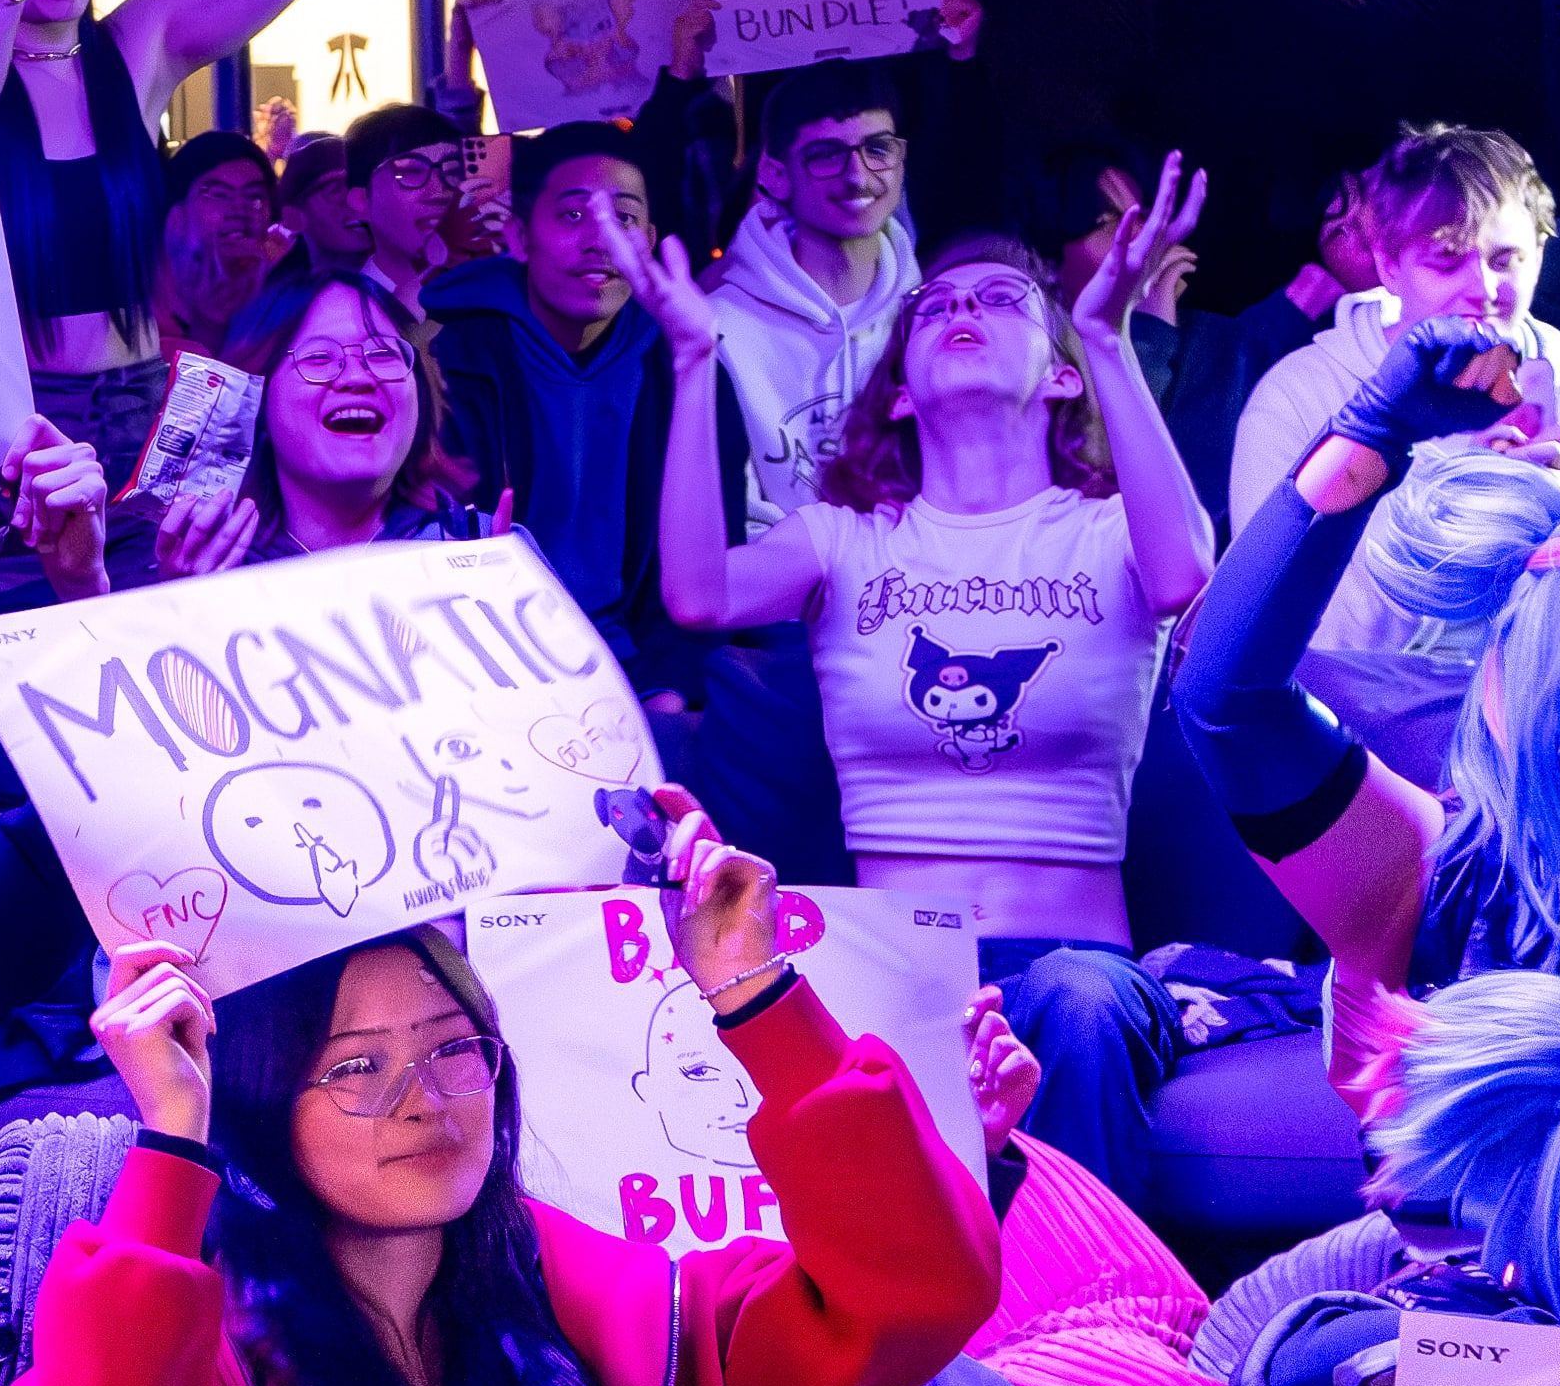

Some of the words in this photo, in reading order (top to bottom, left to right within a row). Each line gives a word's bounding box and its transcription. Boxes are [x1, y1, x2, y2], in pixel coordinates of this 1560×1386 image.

[856, 566, 1105, 636] Kuromi
[17, 589, 600, 804] MOGNATIC
[142, 890, 221, 937] FNC
[480, 914, 548, 929] SONY
[1416, 1339, 1510, 1364] SONY
